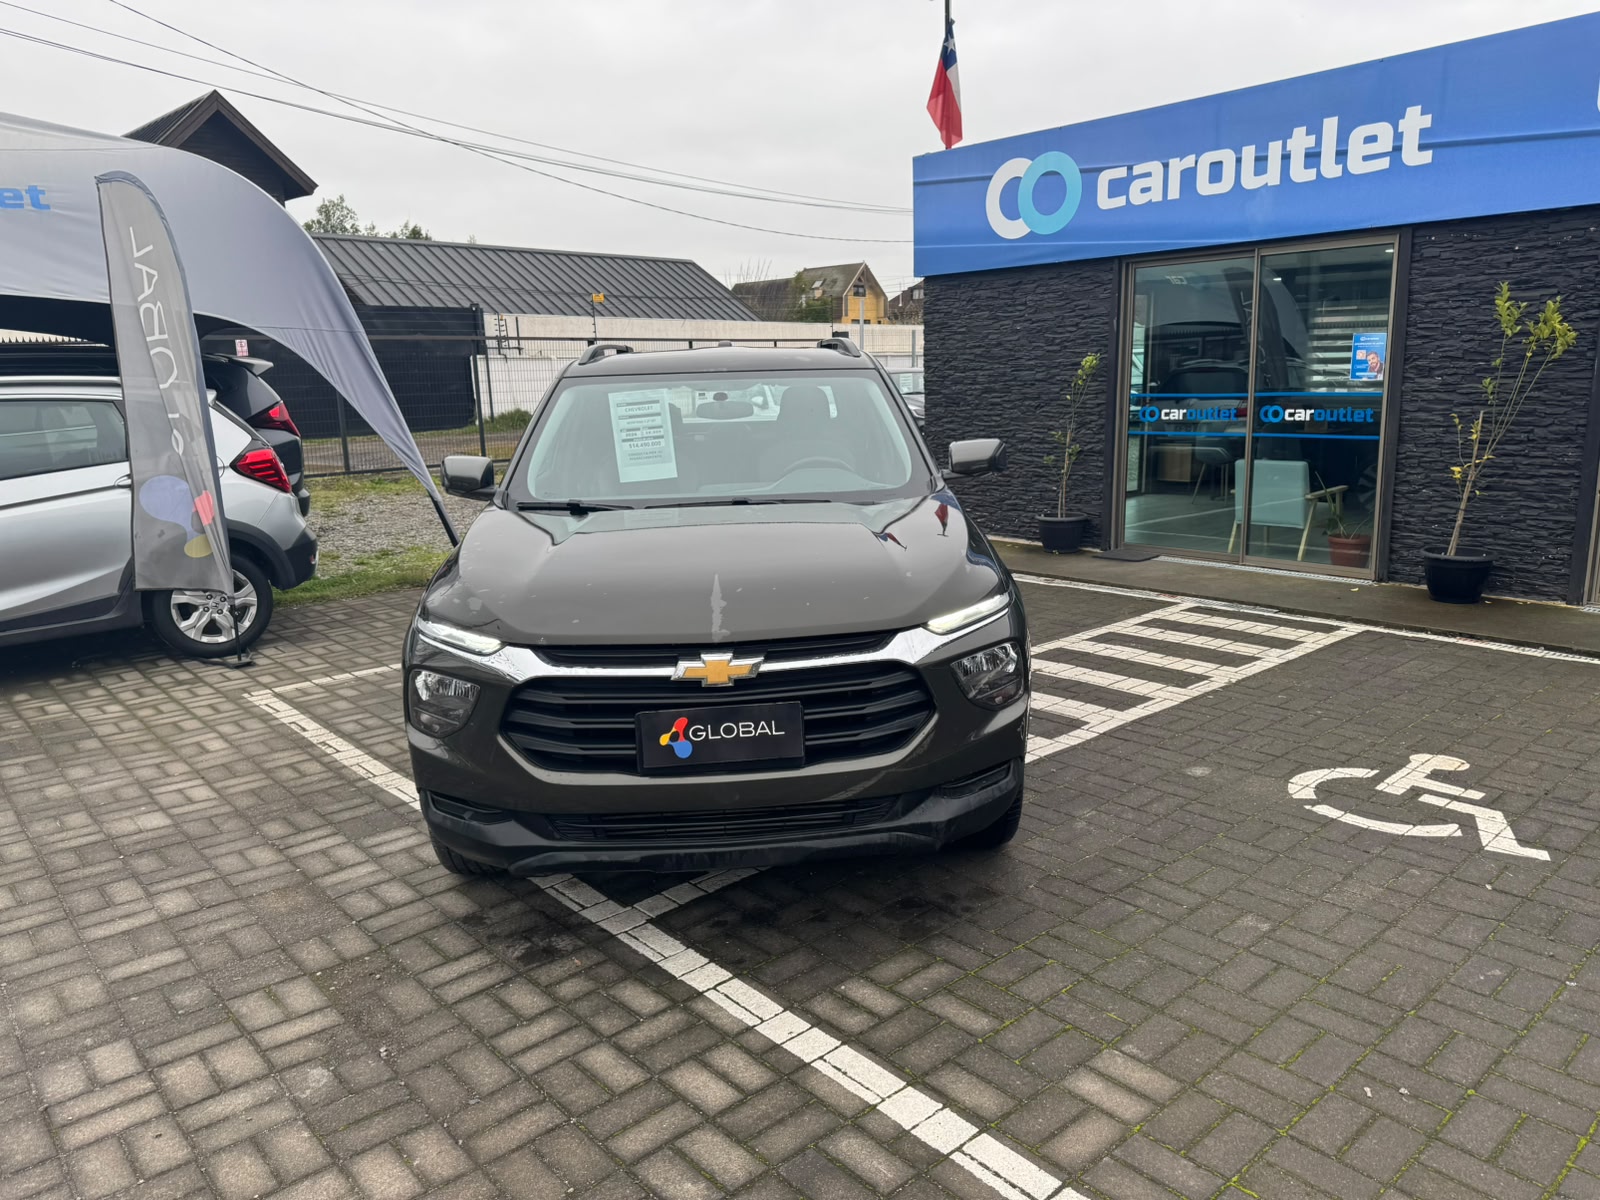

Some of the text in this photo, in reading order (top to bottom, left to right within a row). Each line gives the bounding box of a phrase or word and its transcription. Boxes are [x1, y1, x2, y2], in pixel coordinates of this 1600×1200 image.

[1096, 105, 1433, 211] caroutlet
[1161, 406, 1239, 421] caroutlet
[1284, 406, 1375, 423] caroutlet
[688, 720, 785, 742] GLOBAL
